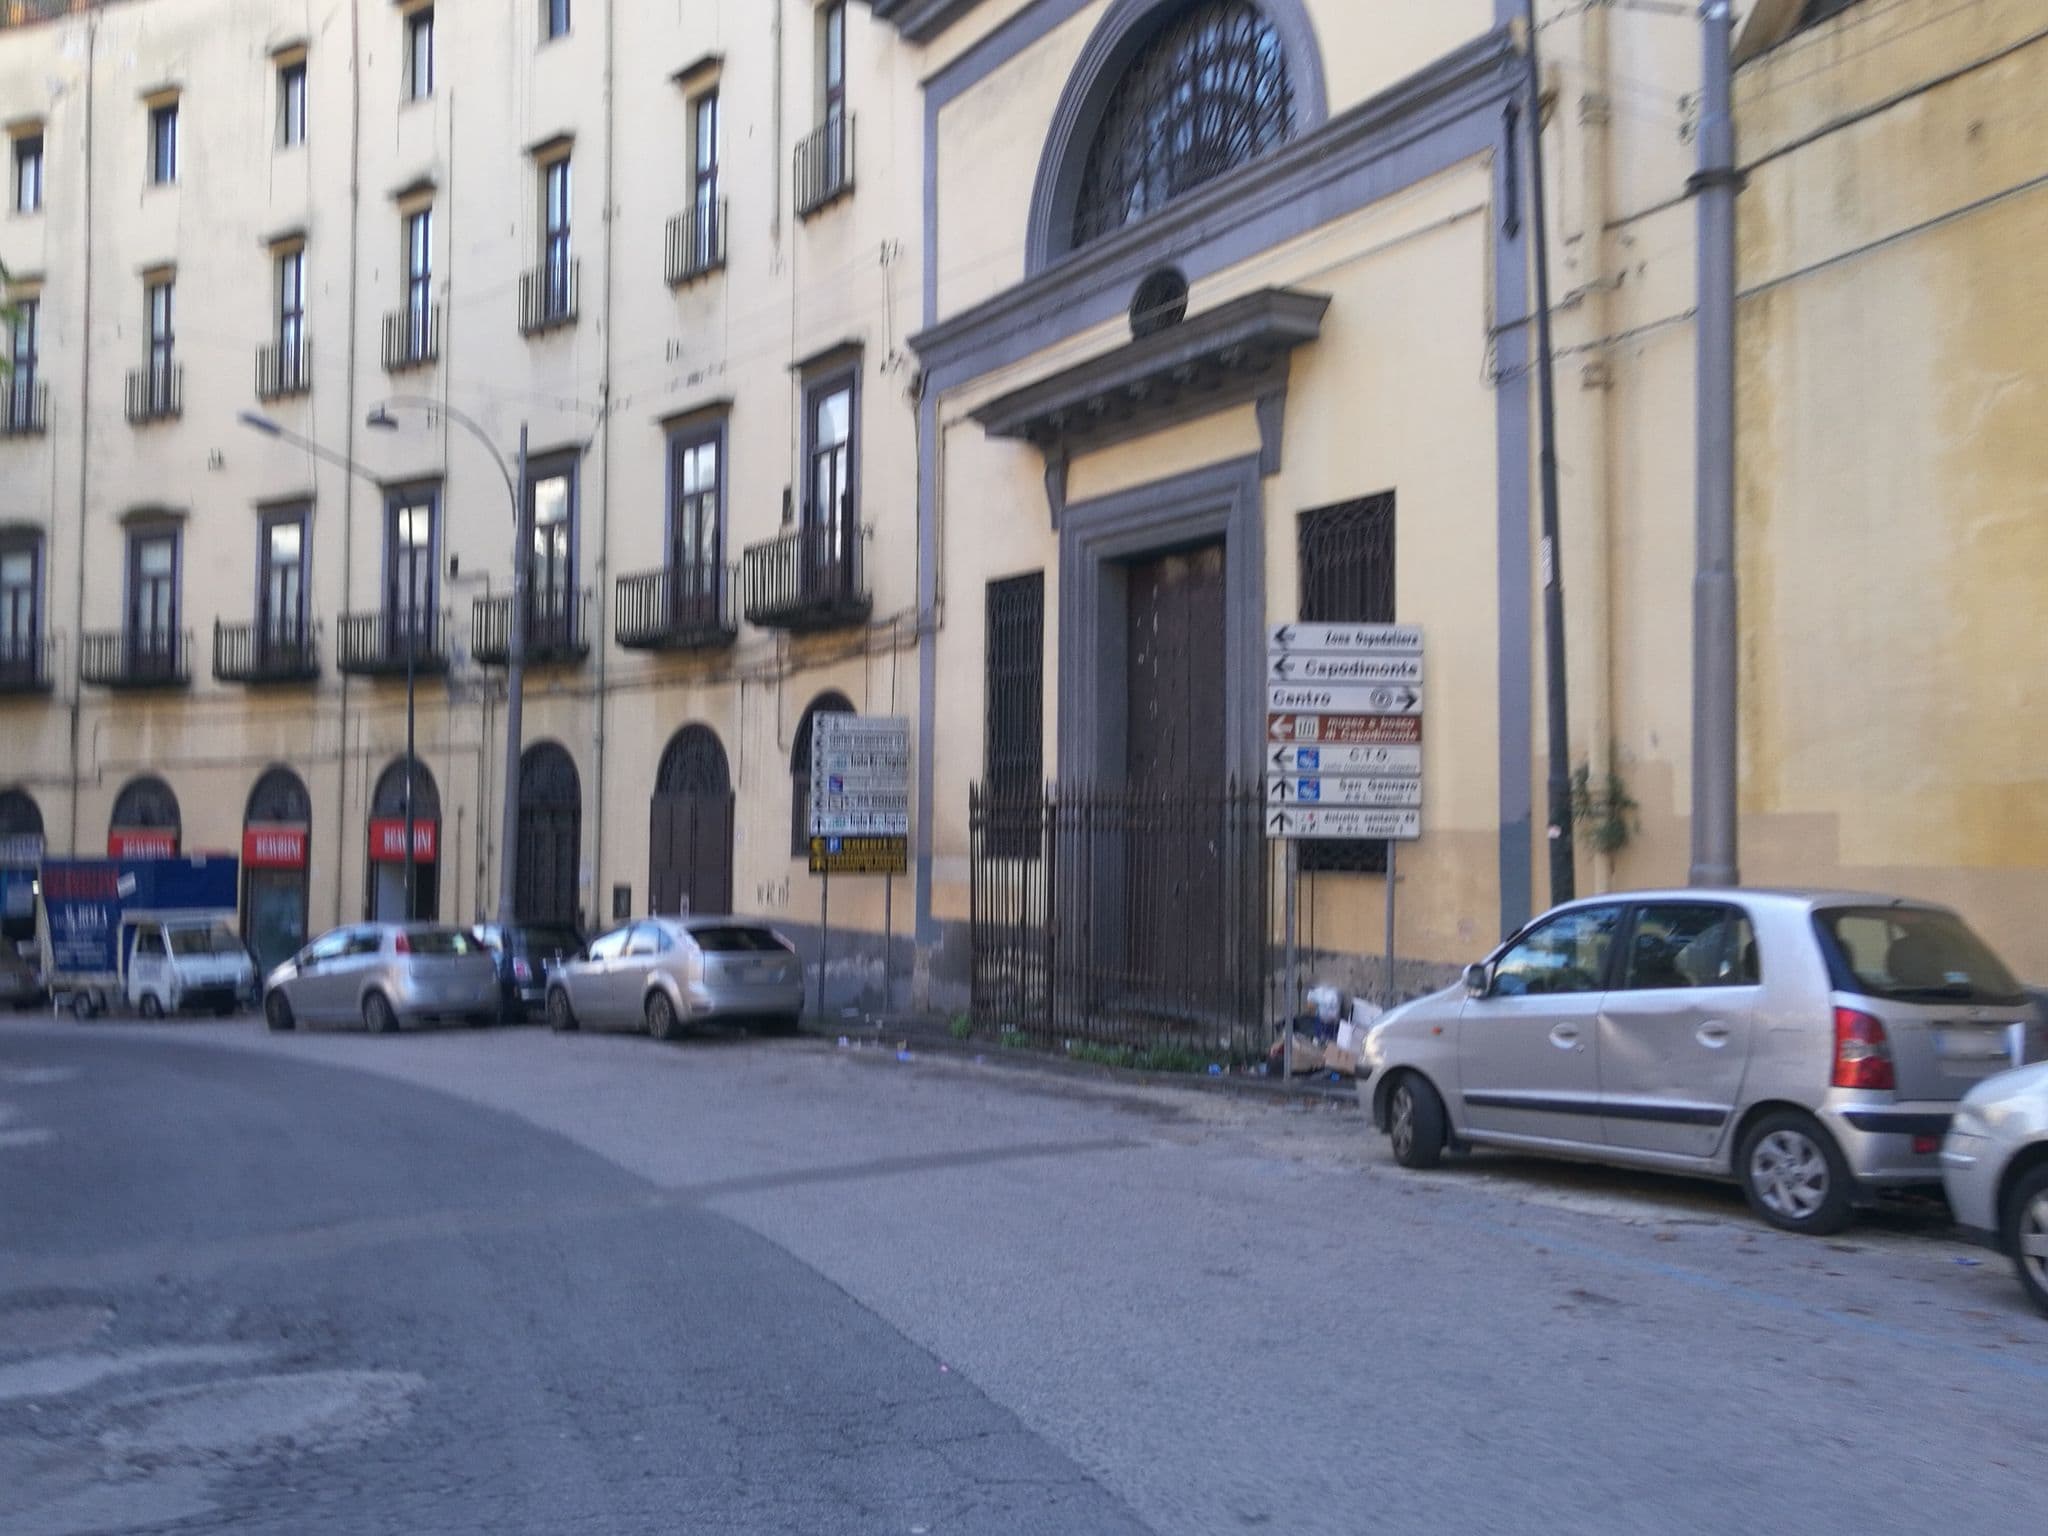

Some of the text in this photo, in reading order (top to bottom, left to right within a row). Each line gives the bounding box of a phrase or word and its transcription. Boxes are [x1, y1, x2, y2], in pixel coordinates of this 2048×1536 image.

[1305, 659, 1417, 678] Capodimonte
[1273, 689, 1331, 706] Centro
[1341, 728, 1417, 742] Capodimonte
